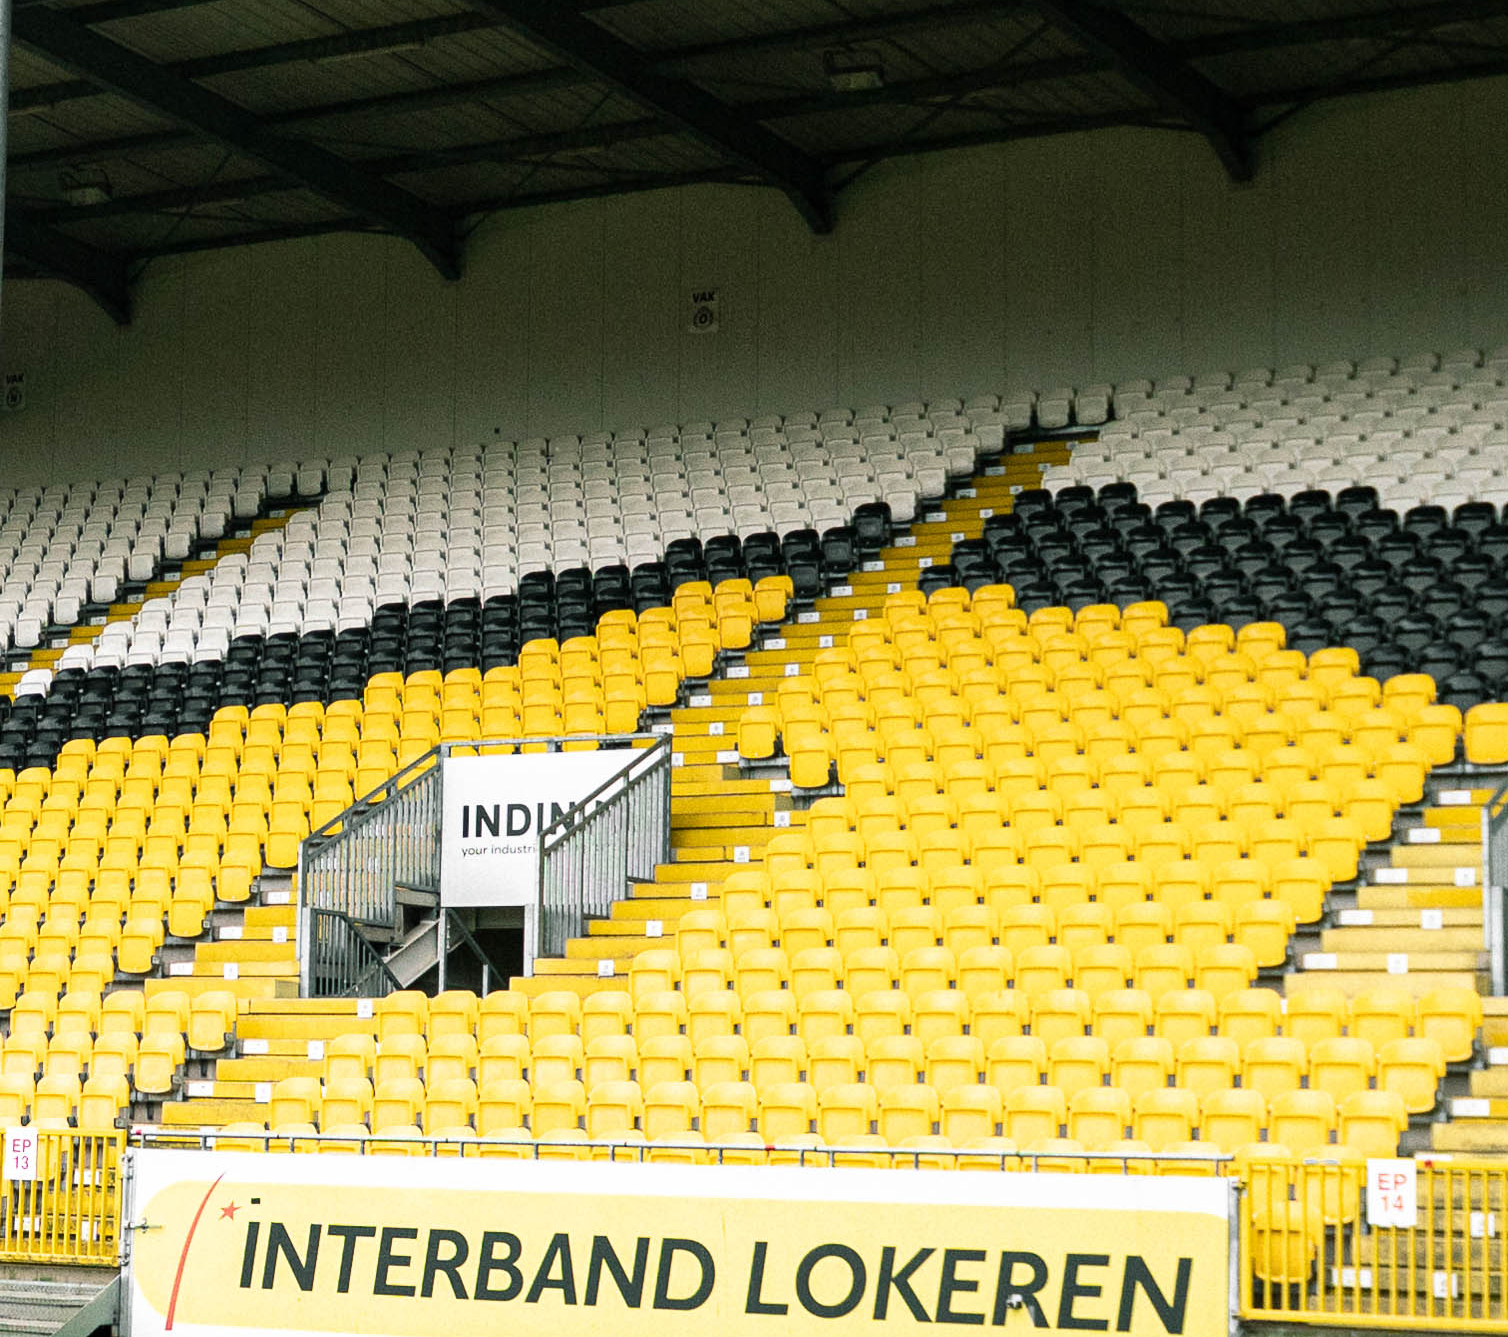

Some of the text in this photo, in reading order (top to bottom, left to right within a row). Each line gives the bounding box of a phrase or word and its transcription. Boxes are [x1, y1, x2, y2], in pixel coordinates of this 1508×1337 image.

[462, 801, 603, 838] INDIN
[462, 843, 536, 857] your industri
[12, 1138, 31, 1152] EP
[13, 1156, 29, 1169] 13
[1378, 1173, 1408, 1191] EP
[1381, 1195, 1404, 1212] 14
[240, 1218, 1193, 1335] INTERBAND LOKEREN
